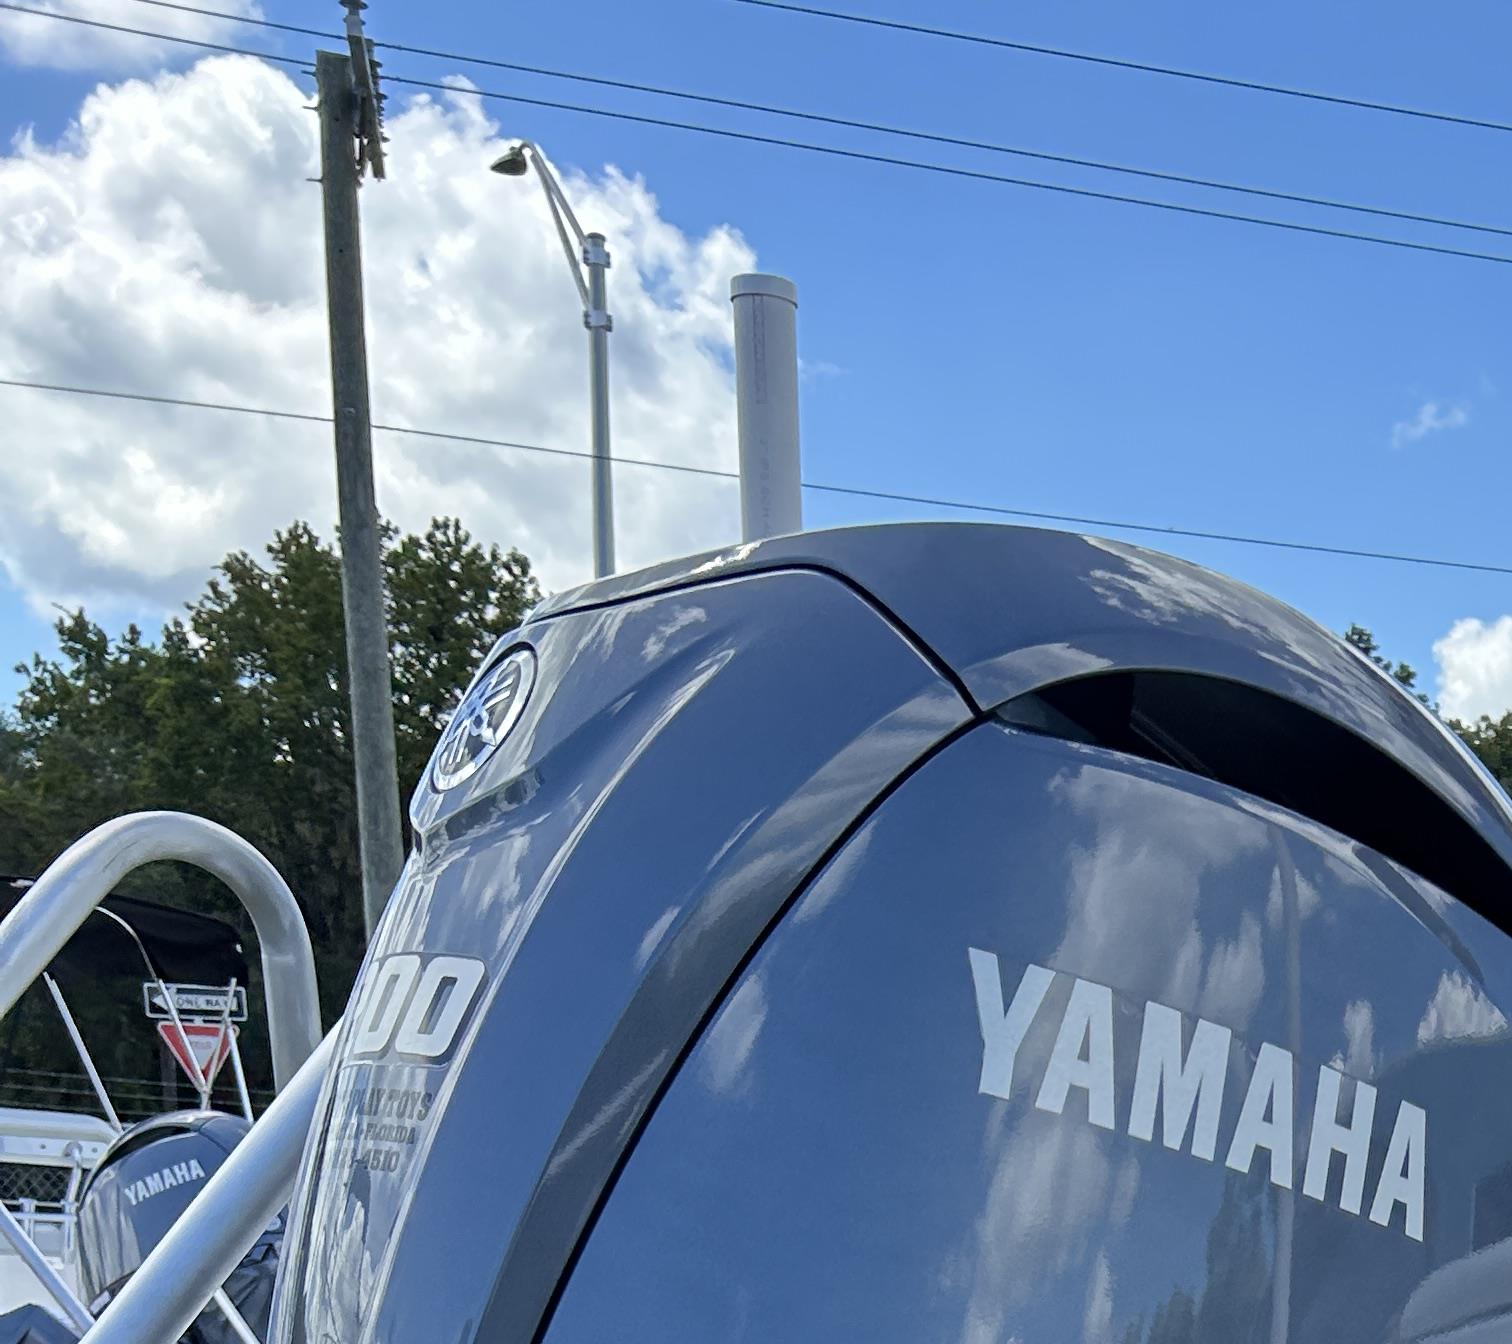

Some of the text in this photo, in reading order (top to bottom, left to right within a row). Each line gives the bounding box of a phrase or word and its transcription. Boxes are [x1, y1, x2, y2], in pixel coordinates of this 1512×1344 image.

[352, 954, 487, 1058] 00
[386, 1089, 433, 1121] TOYS
[968, 947, 1426, 1242] YAMAHA
[124, 1158, 206, 1206] YAMAHA
